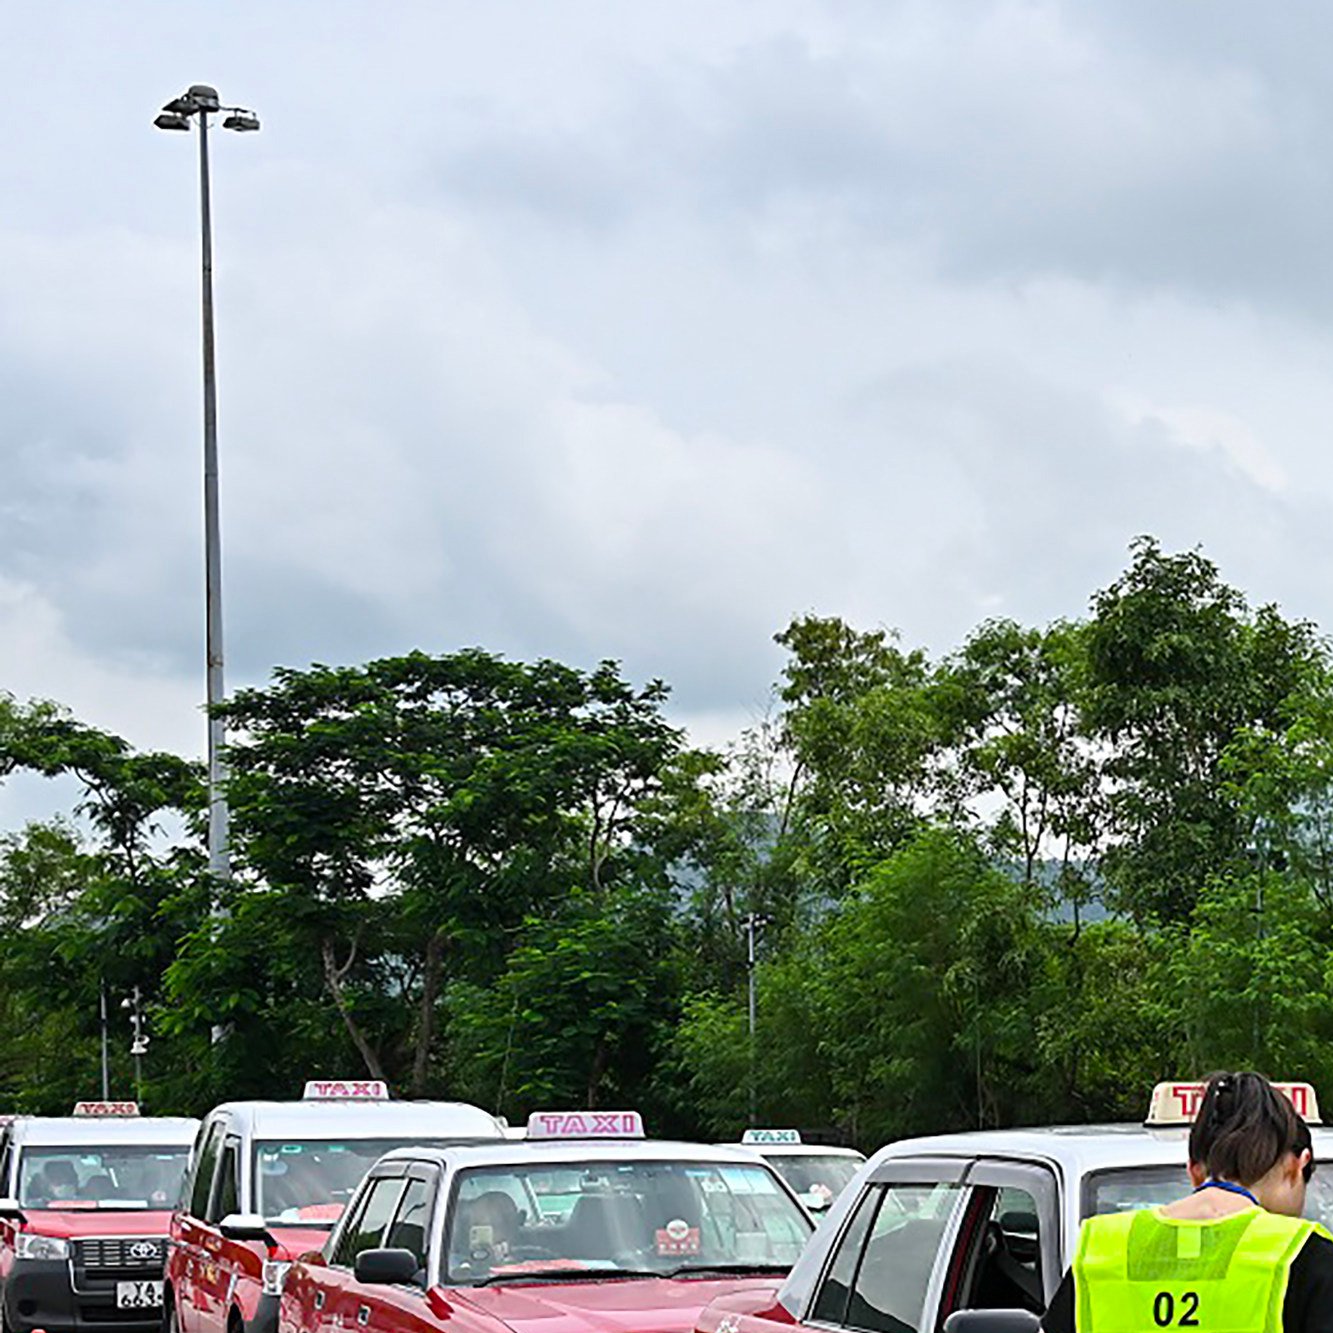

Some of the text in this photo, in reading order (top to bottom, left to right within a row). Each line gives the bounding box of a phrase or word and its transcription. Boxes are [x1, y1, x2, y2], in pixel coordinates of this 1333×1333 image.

[314, 1083, 381, 1095] TAXI
[81, 1103, 135, 1114] TAXI
[540, 1115, 635, 1133] TAXI
[750, 1131, 796, 1142] TAXI
[1153, 1291, 1199, 1327] 02
